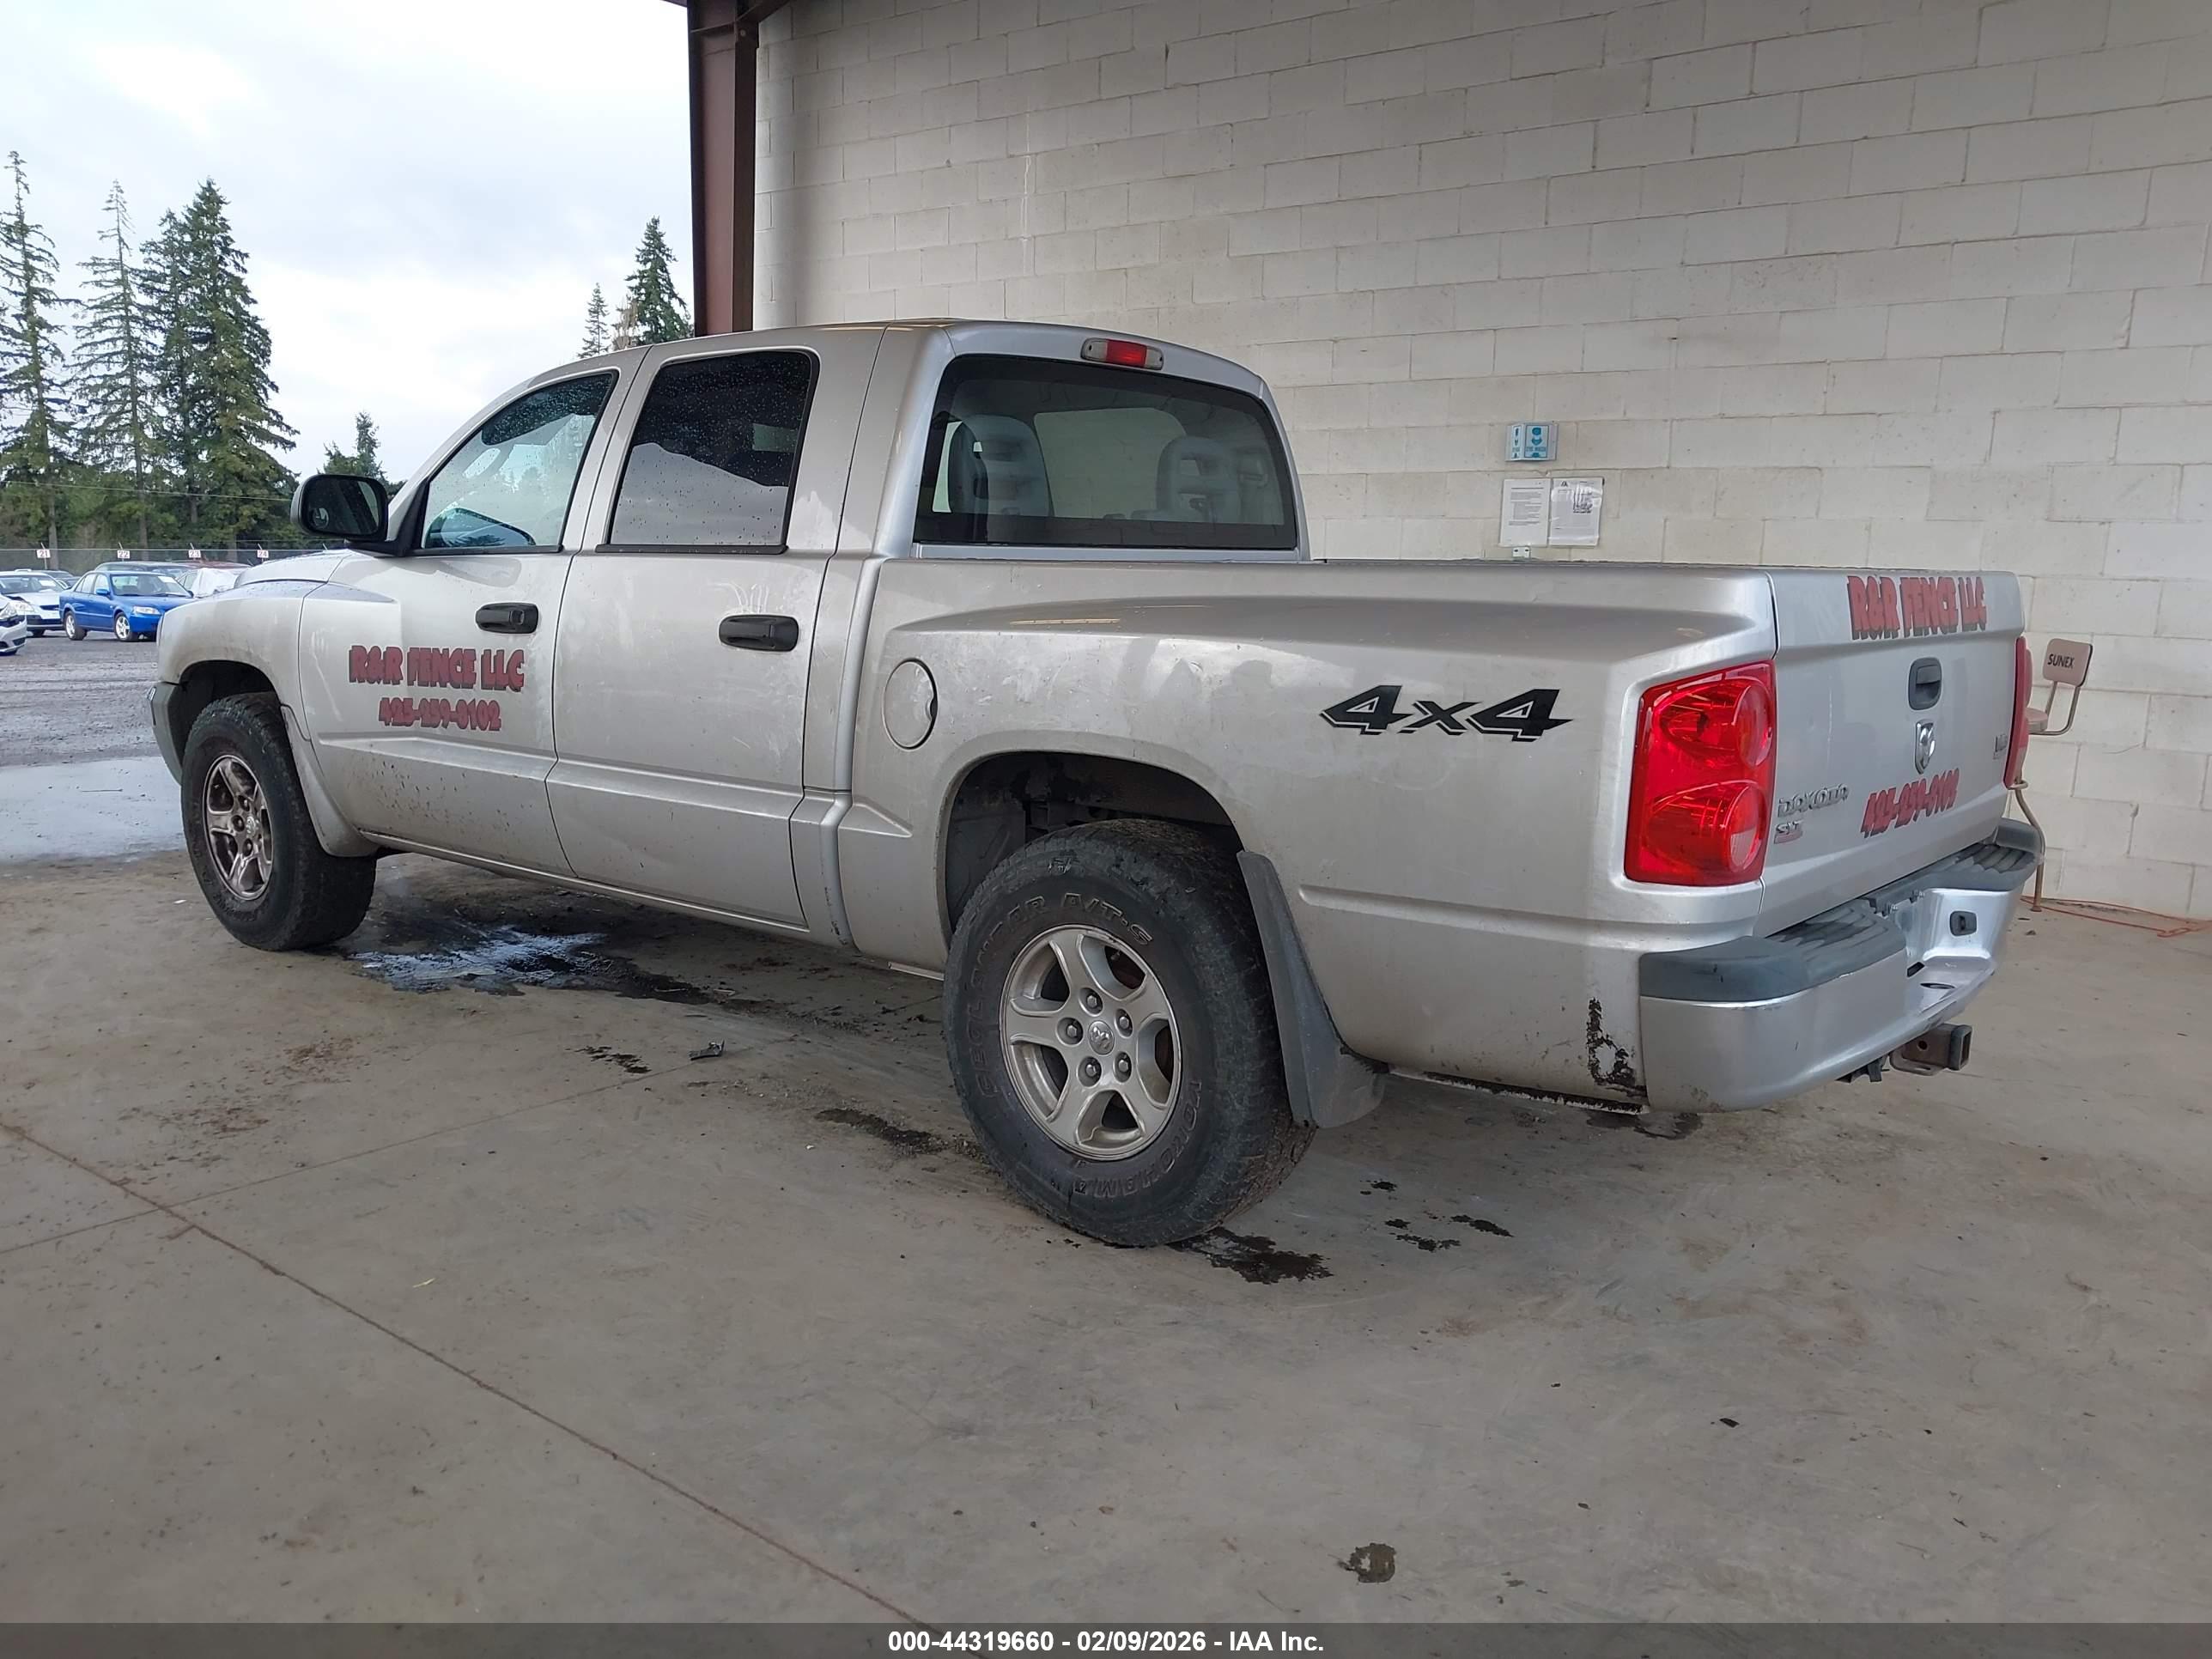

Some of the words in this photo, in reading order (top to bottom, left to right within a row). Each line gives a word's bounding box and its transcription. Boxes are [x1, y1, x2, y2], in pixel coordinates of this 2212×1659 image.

[1847, 576, 1900, 641] R&R
[1899, 577, 1959, 638] FENCE
[1958, 577, 1987, 632] LLC
[349, 646, 404, 685] R&R
[407, 647, 477, 690] FENCE
[481, 649, 525, 692] LLC
[2047, 653, 2075, 669] SUNEX
[1319, 684, 1573, 743] 4x4
